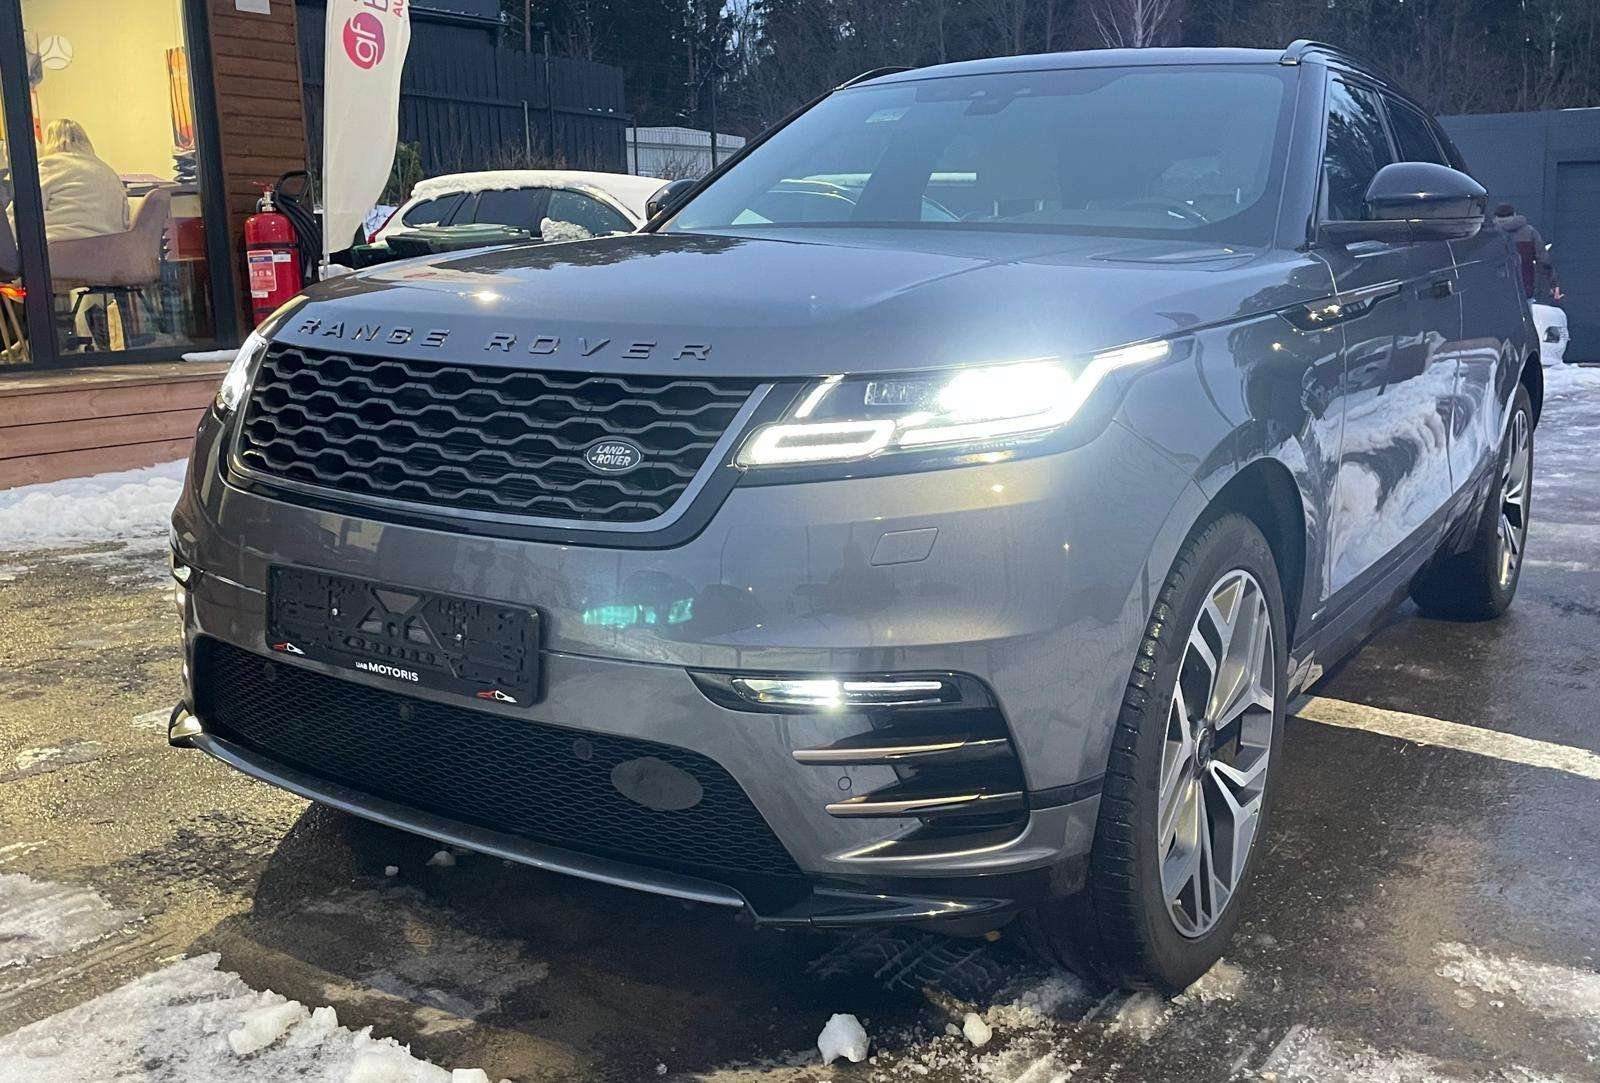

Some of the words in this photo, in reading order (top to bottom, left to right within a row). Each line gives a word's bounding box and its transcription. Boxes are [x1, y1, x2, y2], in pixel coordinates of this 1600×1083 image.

[298, 318, 450, 348] RANGE
[485, 331, 712, 360] ROVER
[368, 662, 419, 682] MOTORIS
